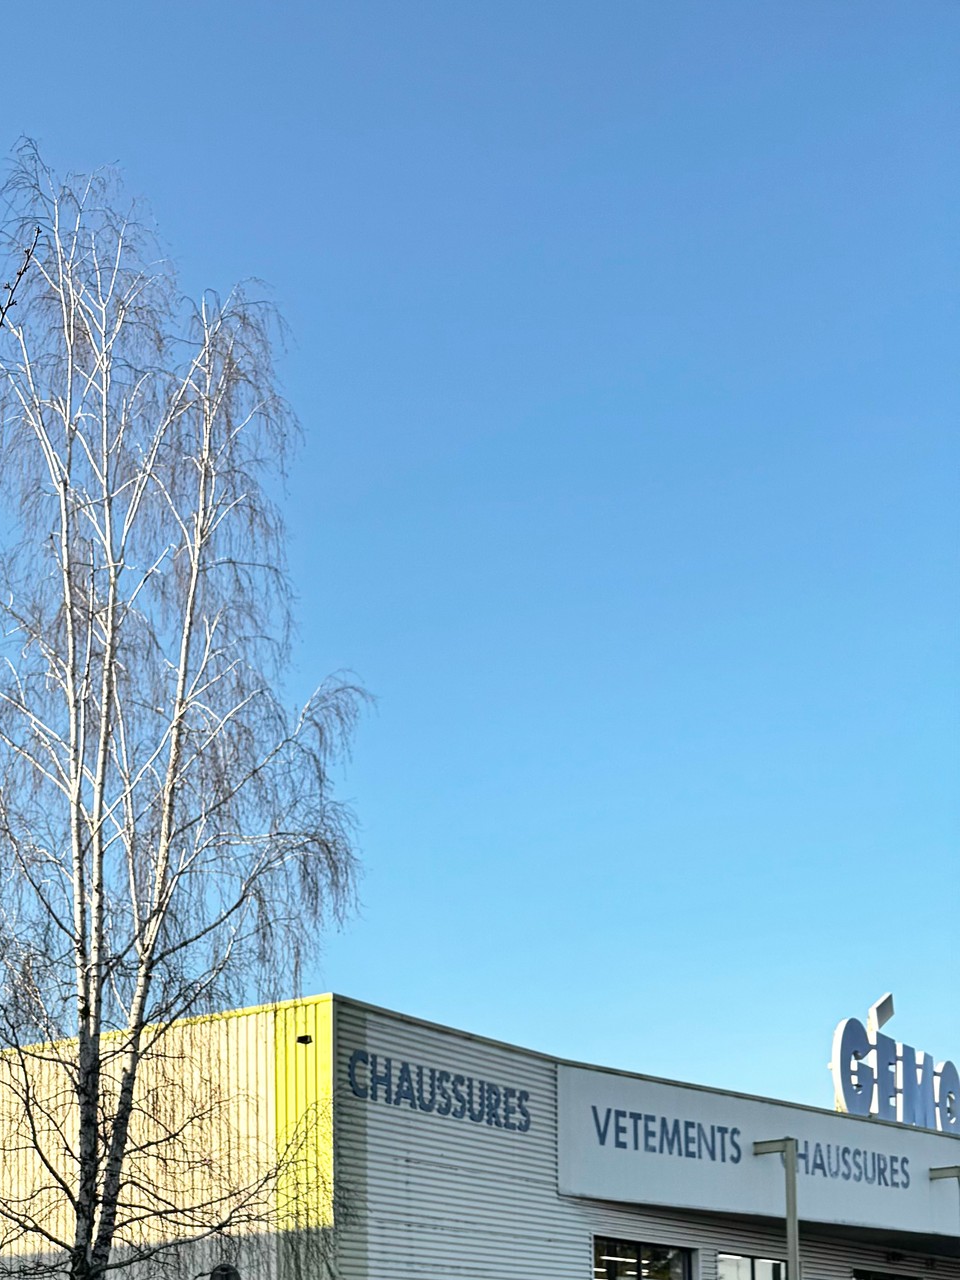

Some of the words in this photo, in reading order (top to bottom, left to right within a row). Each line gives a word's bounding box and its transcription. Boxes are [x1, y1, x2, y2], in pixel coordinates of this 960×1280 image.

[348, 1049, 531, 1133] CHAUSSURES
[591, 1104, 742, 1164] VETEMENTS
[780, 1139, 911, 1189] HAUSSURES
